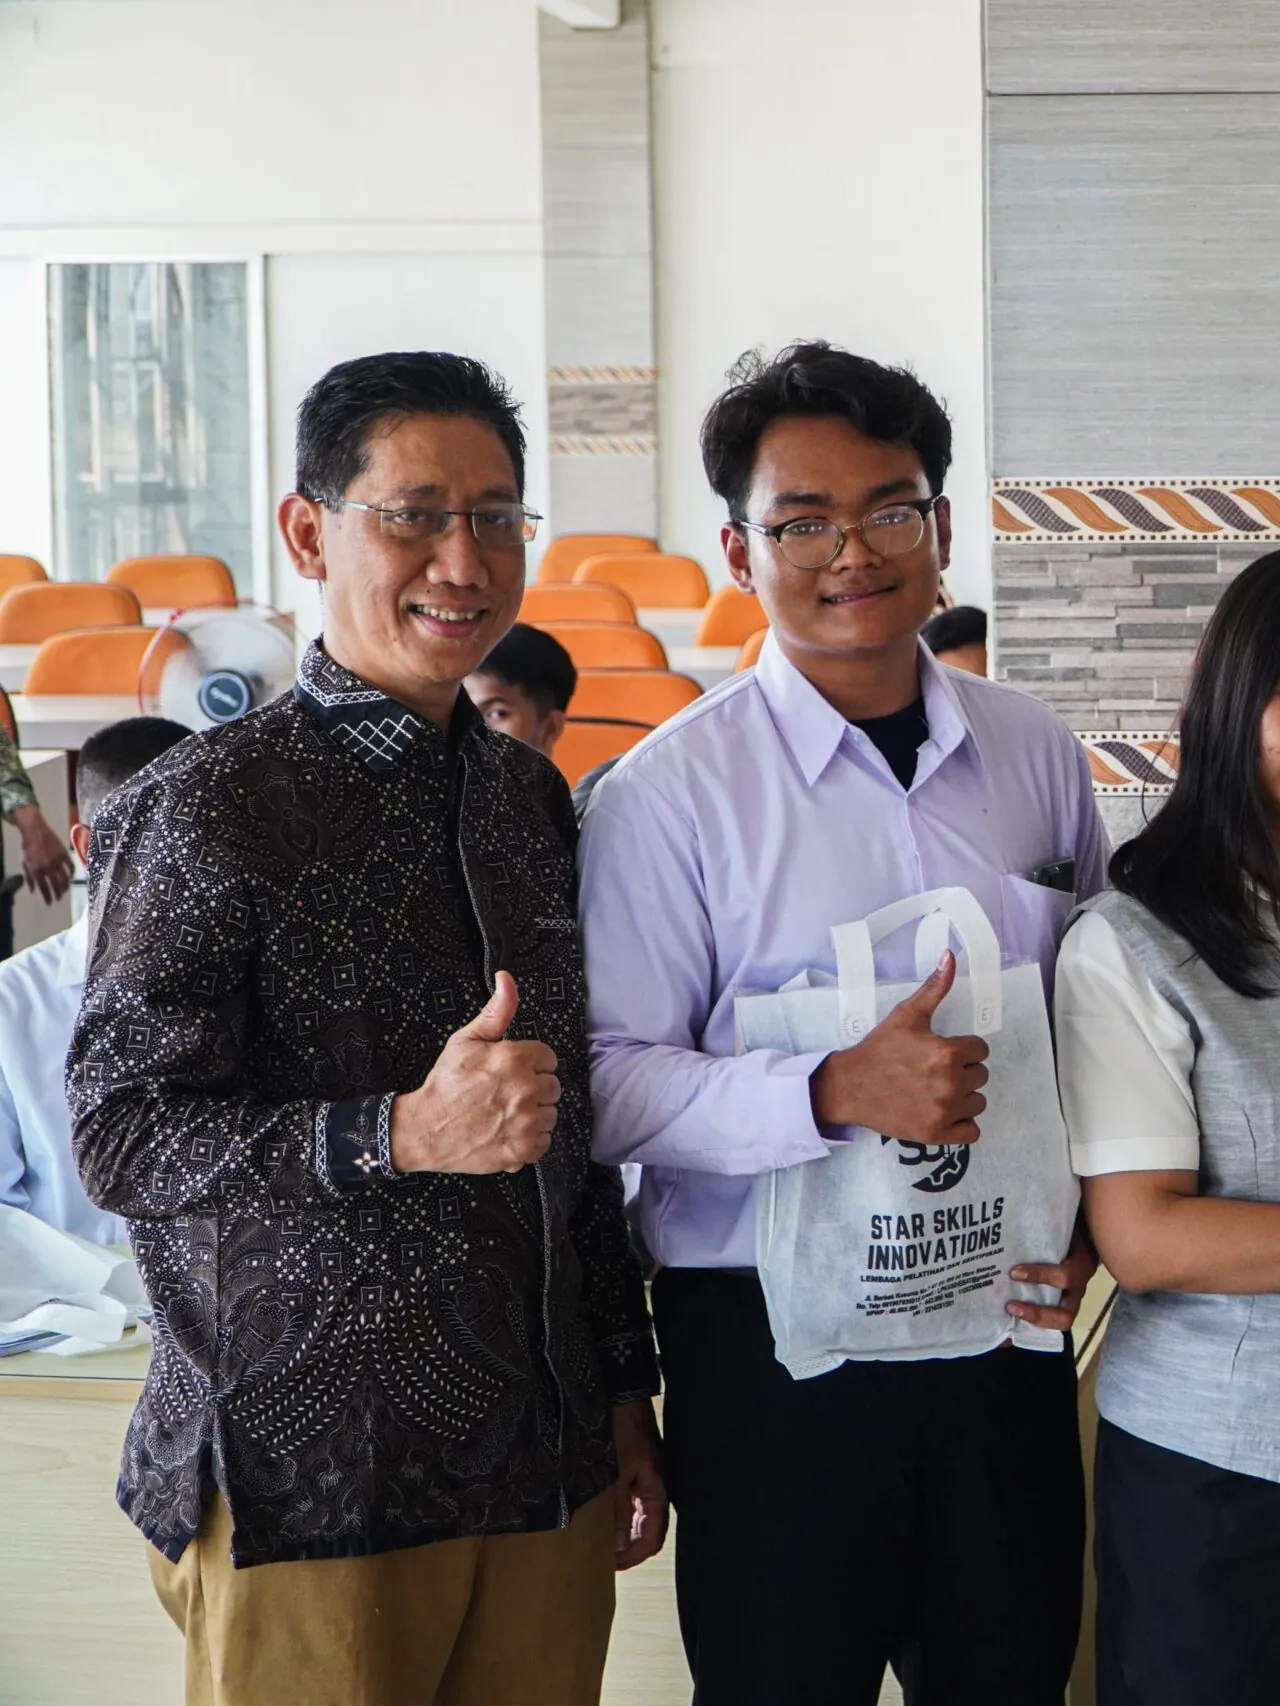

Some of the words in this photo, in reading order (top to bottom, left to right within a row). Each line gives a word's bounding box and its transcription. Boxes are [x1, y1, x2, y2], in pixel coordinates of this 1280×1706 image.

[871, 1213, 925, 1240] STAR
[933, 1197, 1005, 1234] SKILLS
[860, 1275, 901, 1283] LEMBAGA
[903, 1266, 946, 1281] PELATIHAN
[946, 1261, 961, 1270] DAN
[962, 1247, 1004, 1264] SERTIFIKASI
[867, 1222, 1002, 1270] INNOVATIONS
